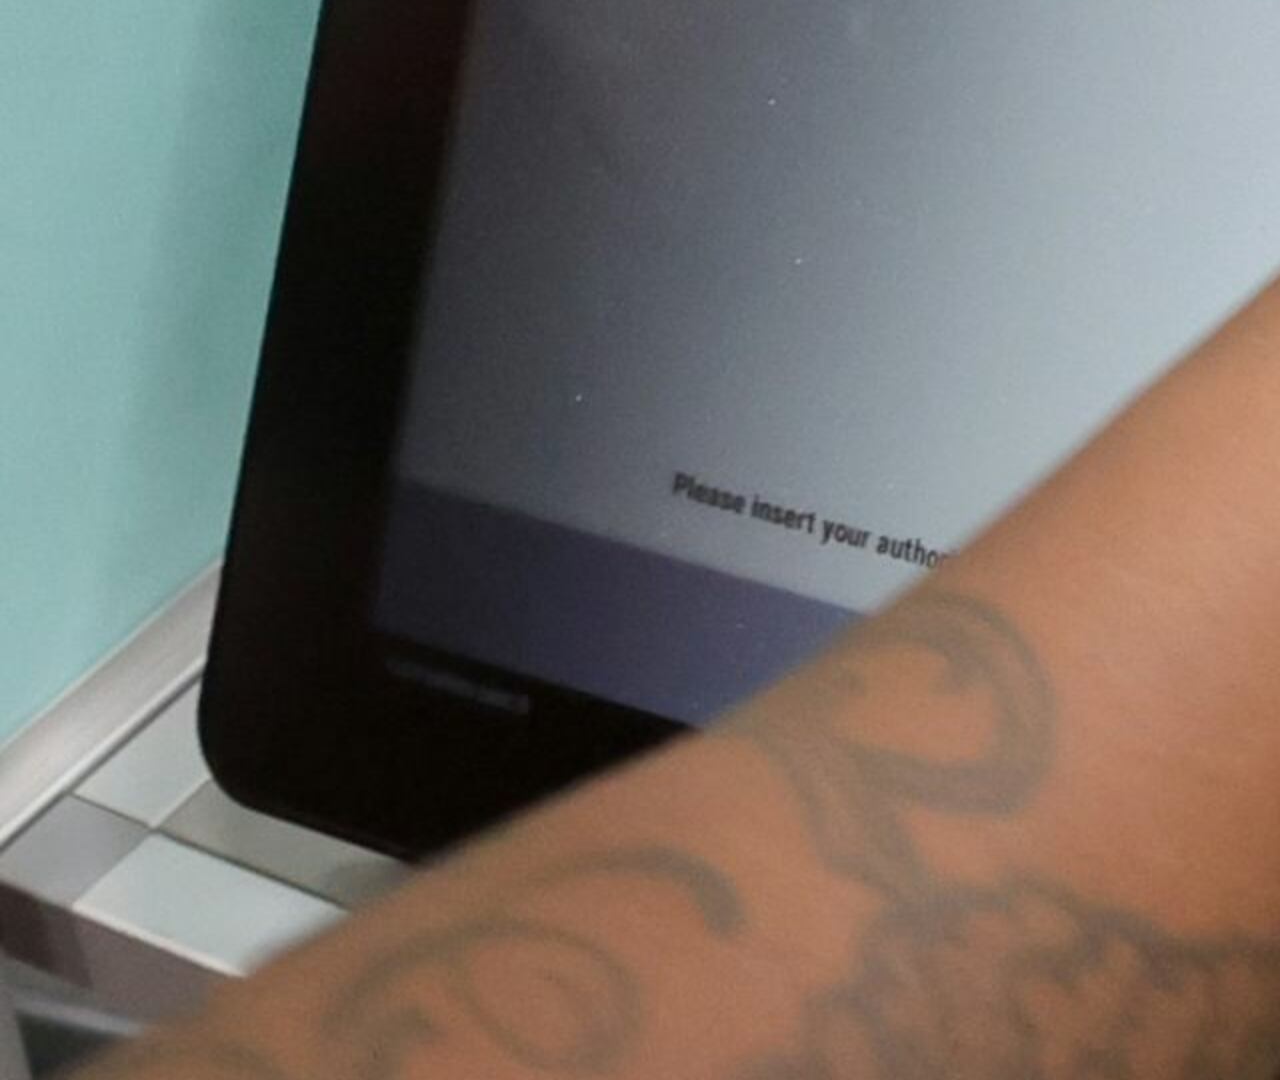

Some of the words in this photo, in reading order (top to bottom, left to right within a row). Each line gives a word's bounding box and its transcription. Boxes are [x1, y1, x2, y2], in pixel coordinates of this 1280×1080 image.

[673, 472, 745, 514] Please
[751, 493, 816, 534] insert
[820, 520, 871, 547] your
